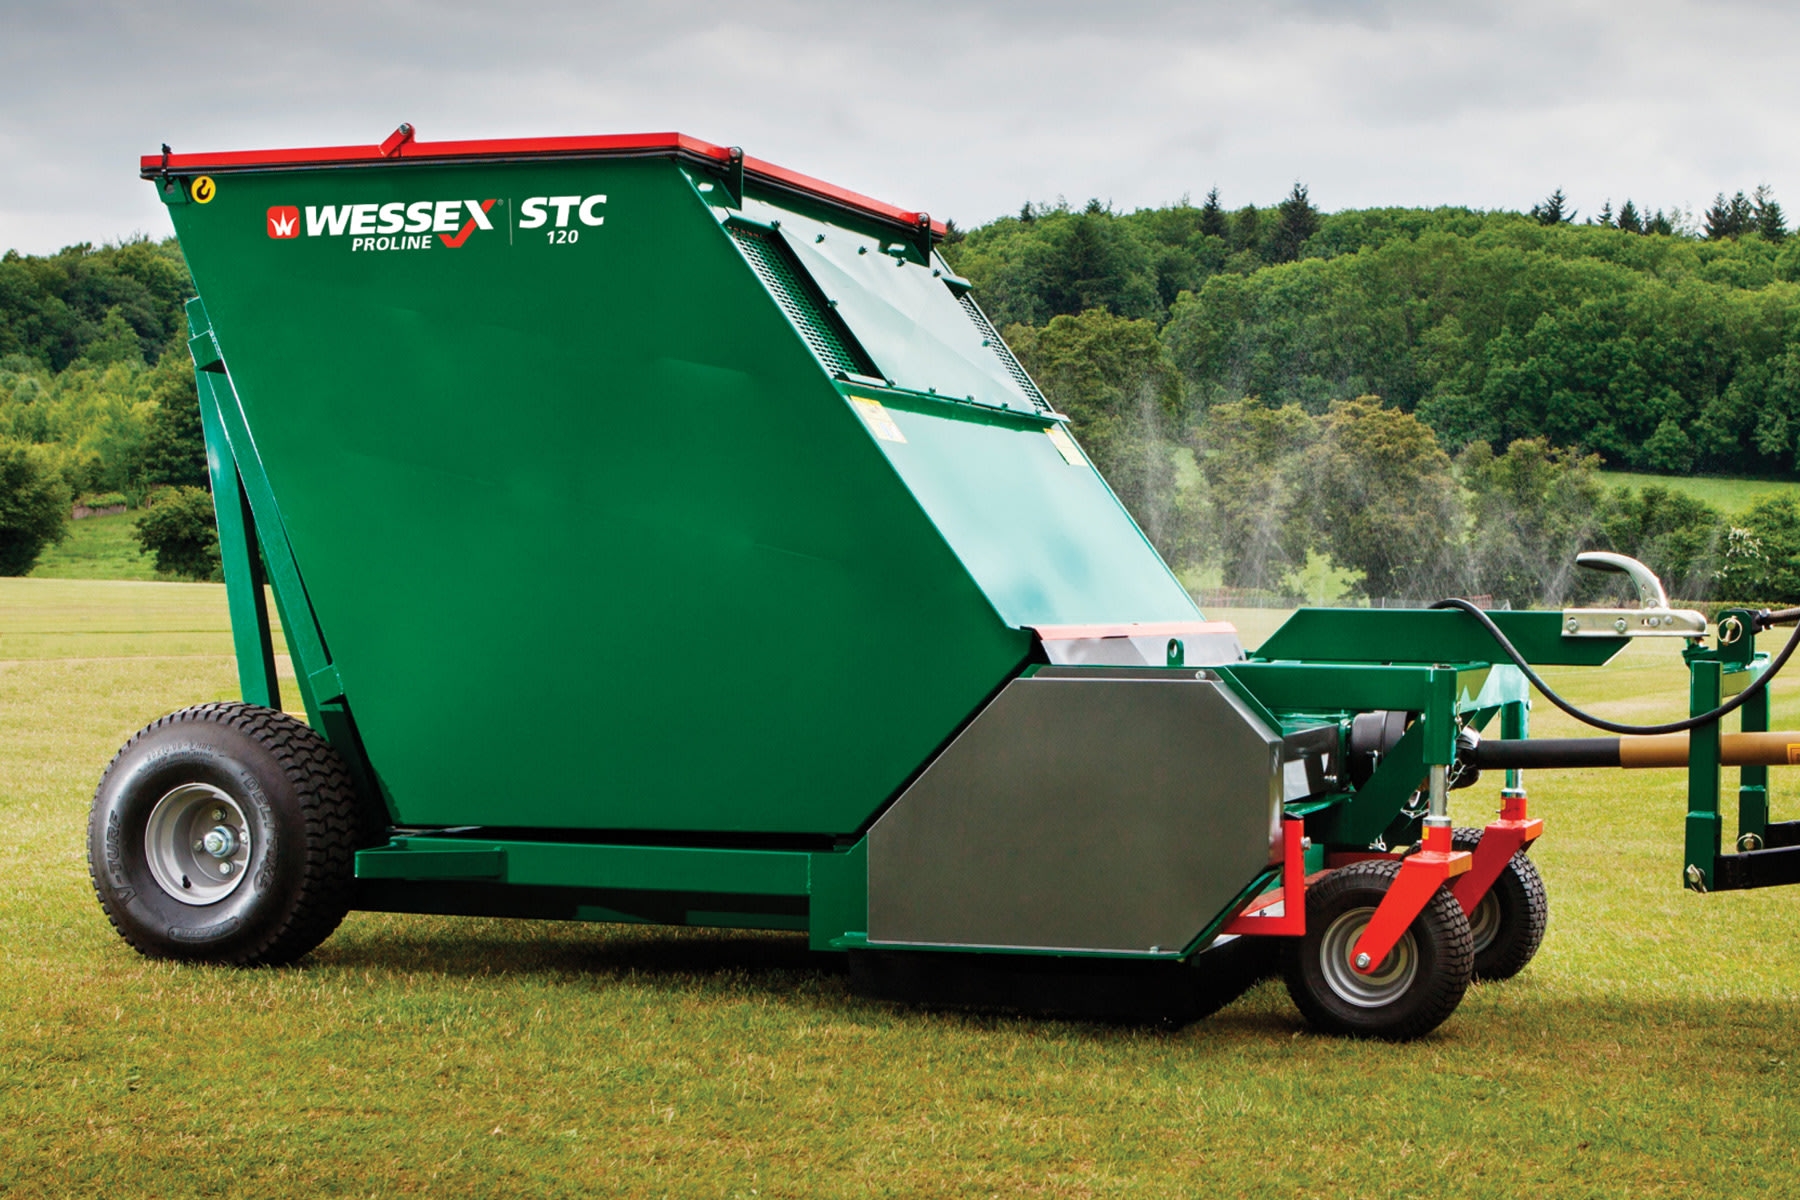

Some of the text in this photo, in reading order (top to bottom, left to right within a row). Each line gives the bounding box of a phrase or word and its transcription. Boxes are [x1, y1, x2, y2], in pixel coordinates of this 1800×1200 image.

[304, 199, 498, 248] WESSEX
[518, 194, 607, 229] STC
[351, 235, 433, 252] PROLINE
[546, 229, 580, 246] 120
[107, 809, 137, 905] V-TURF
